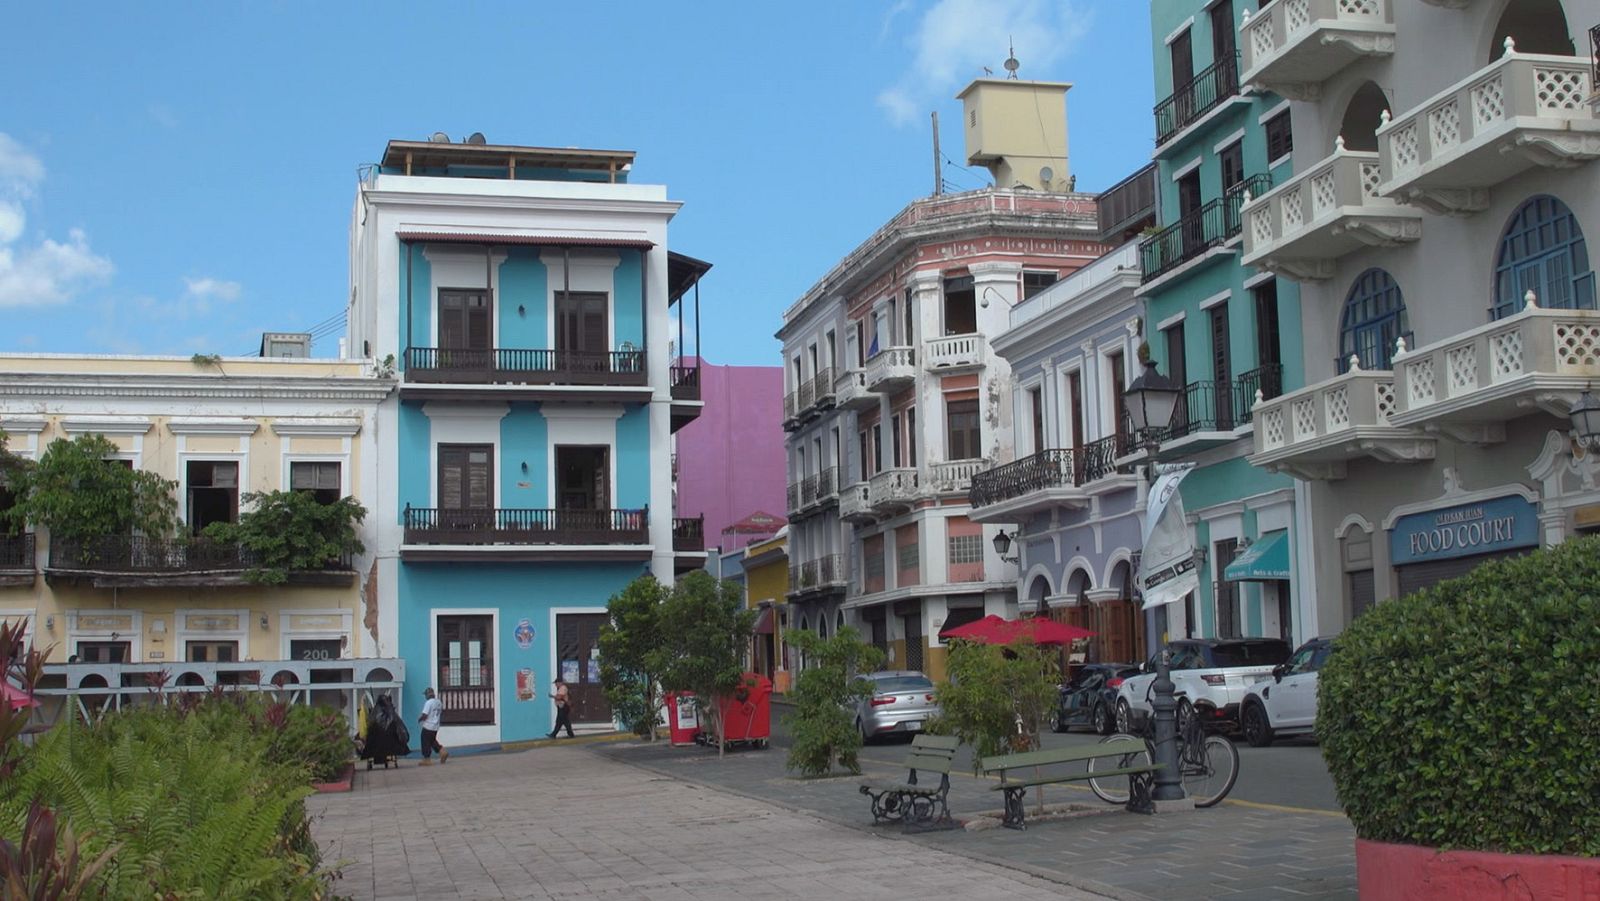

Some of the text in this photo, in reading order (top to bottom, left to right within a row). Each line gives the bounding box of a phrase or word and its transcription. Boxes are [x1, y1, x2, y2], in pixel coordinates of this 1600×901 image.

[1450, 510, 1465, 522] SAN
[1410, 516, 1514, 555] FOOD COURT
[303, 649, 329, 660] 200
